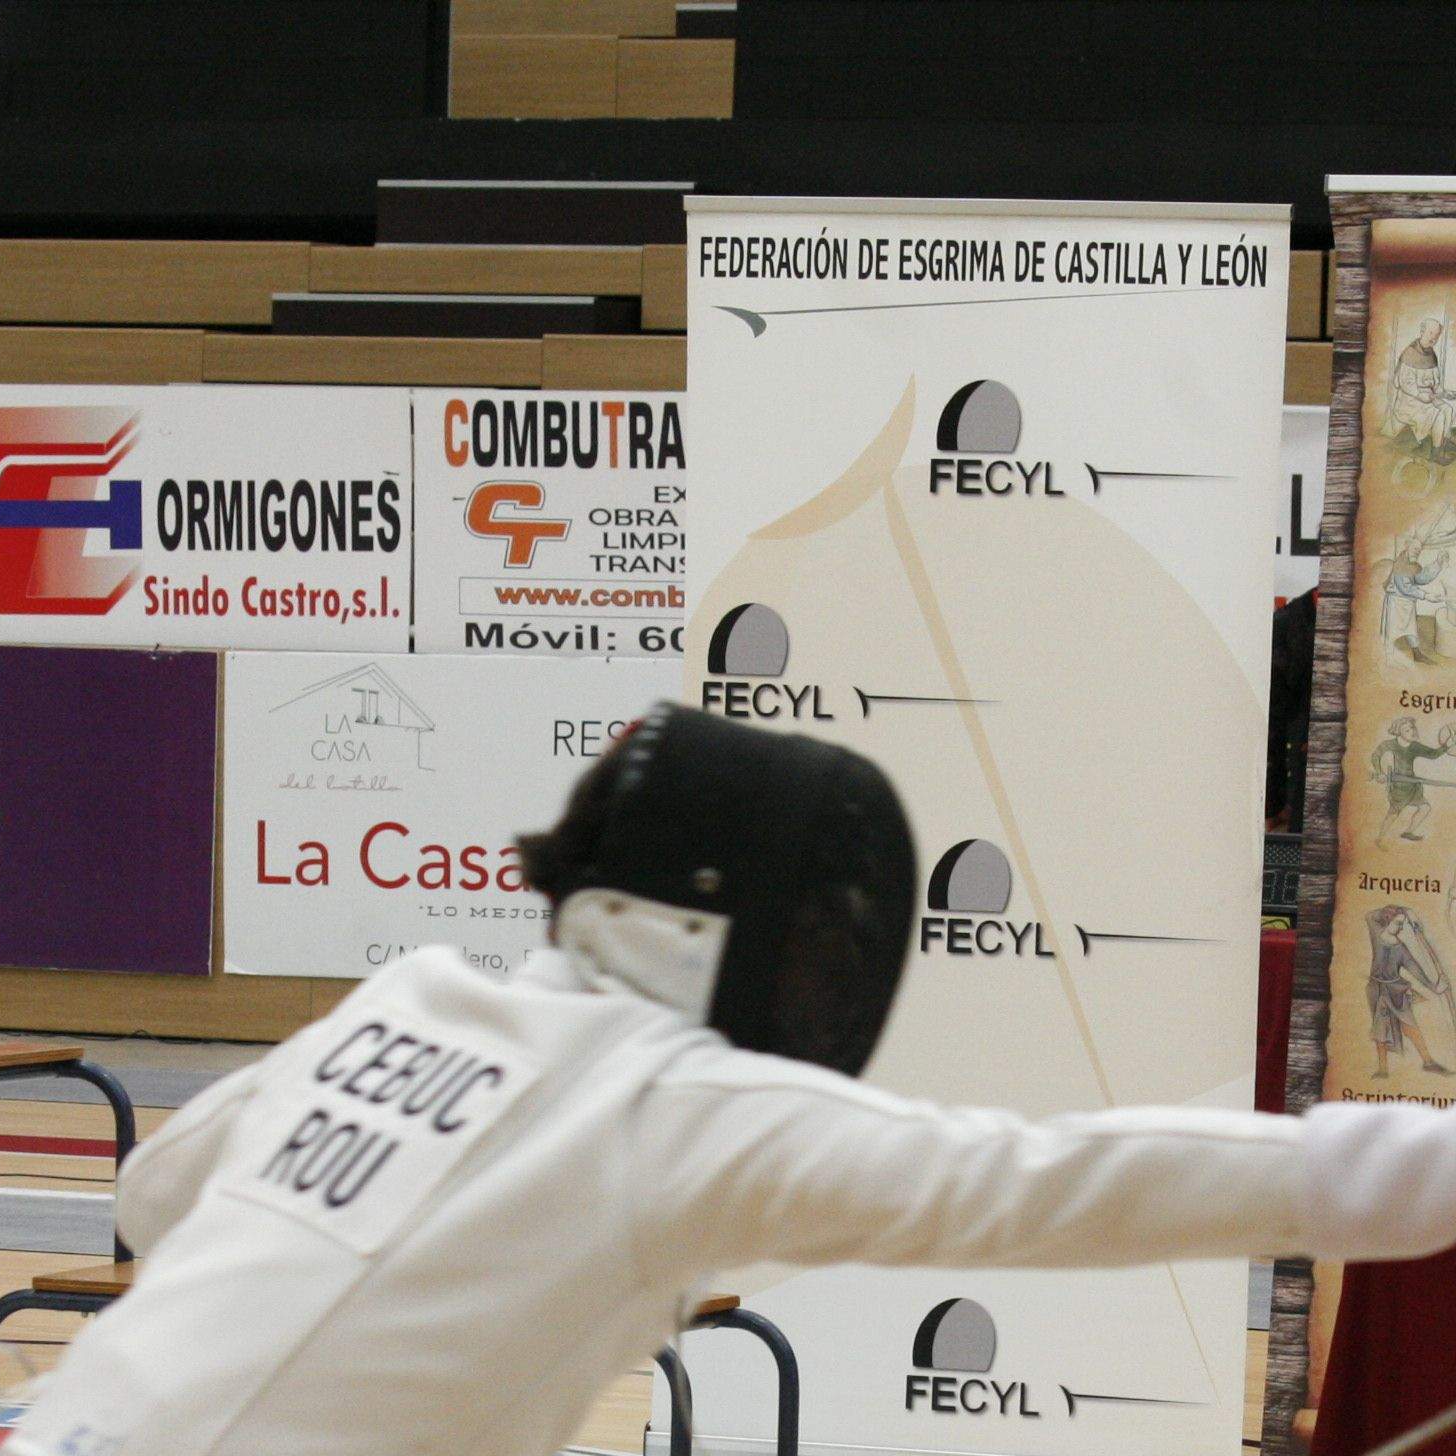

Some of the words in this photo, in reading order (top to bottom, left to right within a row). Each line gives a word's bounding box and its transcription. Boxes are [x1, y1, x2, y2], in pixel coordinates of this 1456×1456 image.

[699, 227, 848, 279] FEDERACIÓN
[858, 237, 889, 280] DE
[899, 239, 1005, 282] ESGRIMA
[1015, 240, 1046, 283] DE
[1055, 241, 1167, 285] CASTILLA
[1178, 243, 1193, 285] Y
[1202, 234, 1267, 288] LEÓN
[444, 398, 687, 470] COMBUTRA
[929, 458, 1064, 496] FECYL
[157, 478, 401, 554] ORMIGONES
[588, 507, 679, 527] OBRA
[144, 573, 229, 618] Sindo
[466, 620, 617, 652] Móvil:
[701, 681, 834, 720] FECYL
[257, 820, 330, 886] La
[359, 821, 532, 893] Casa
[920, 917, 1056, 957] FECYL
[257, 1108, 400, 1210] ROU
[905, 1374, 1043, 1418] FECYL
